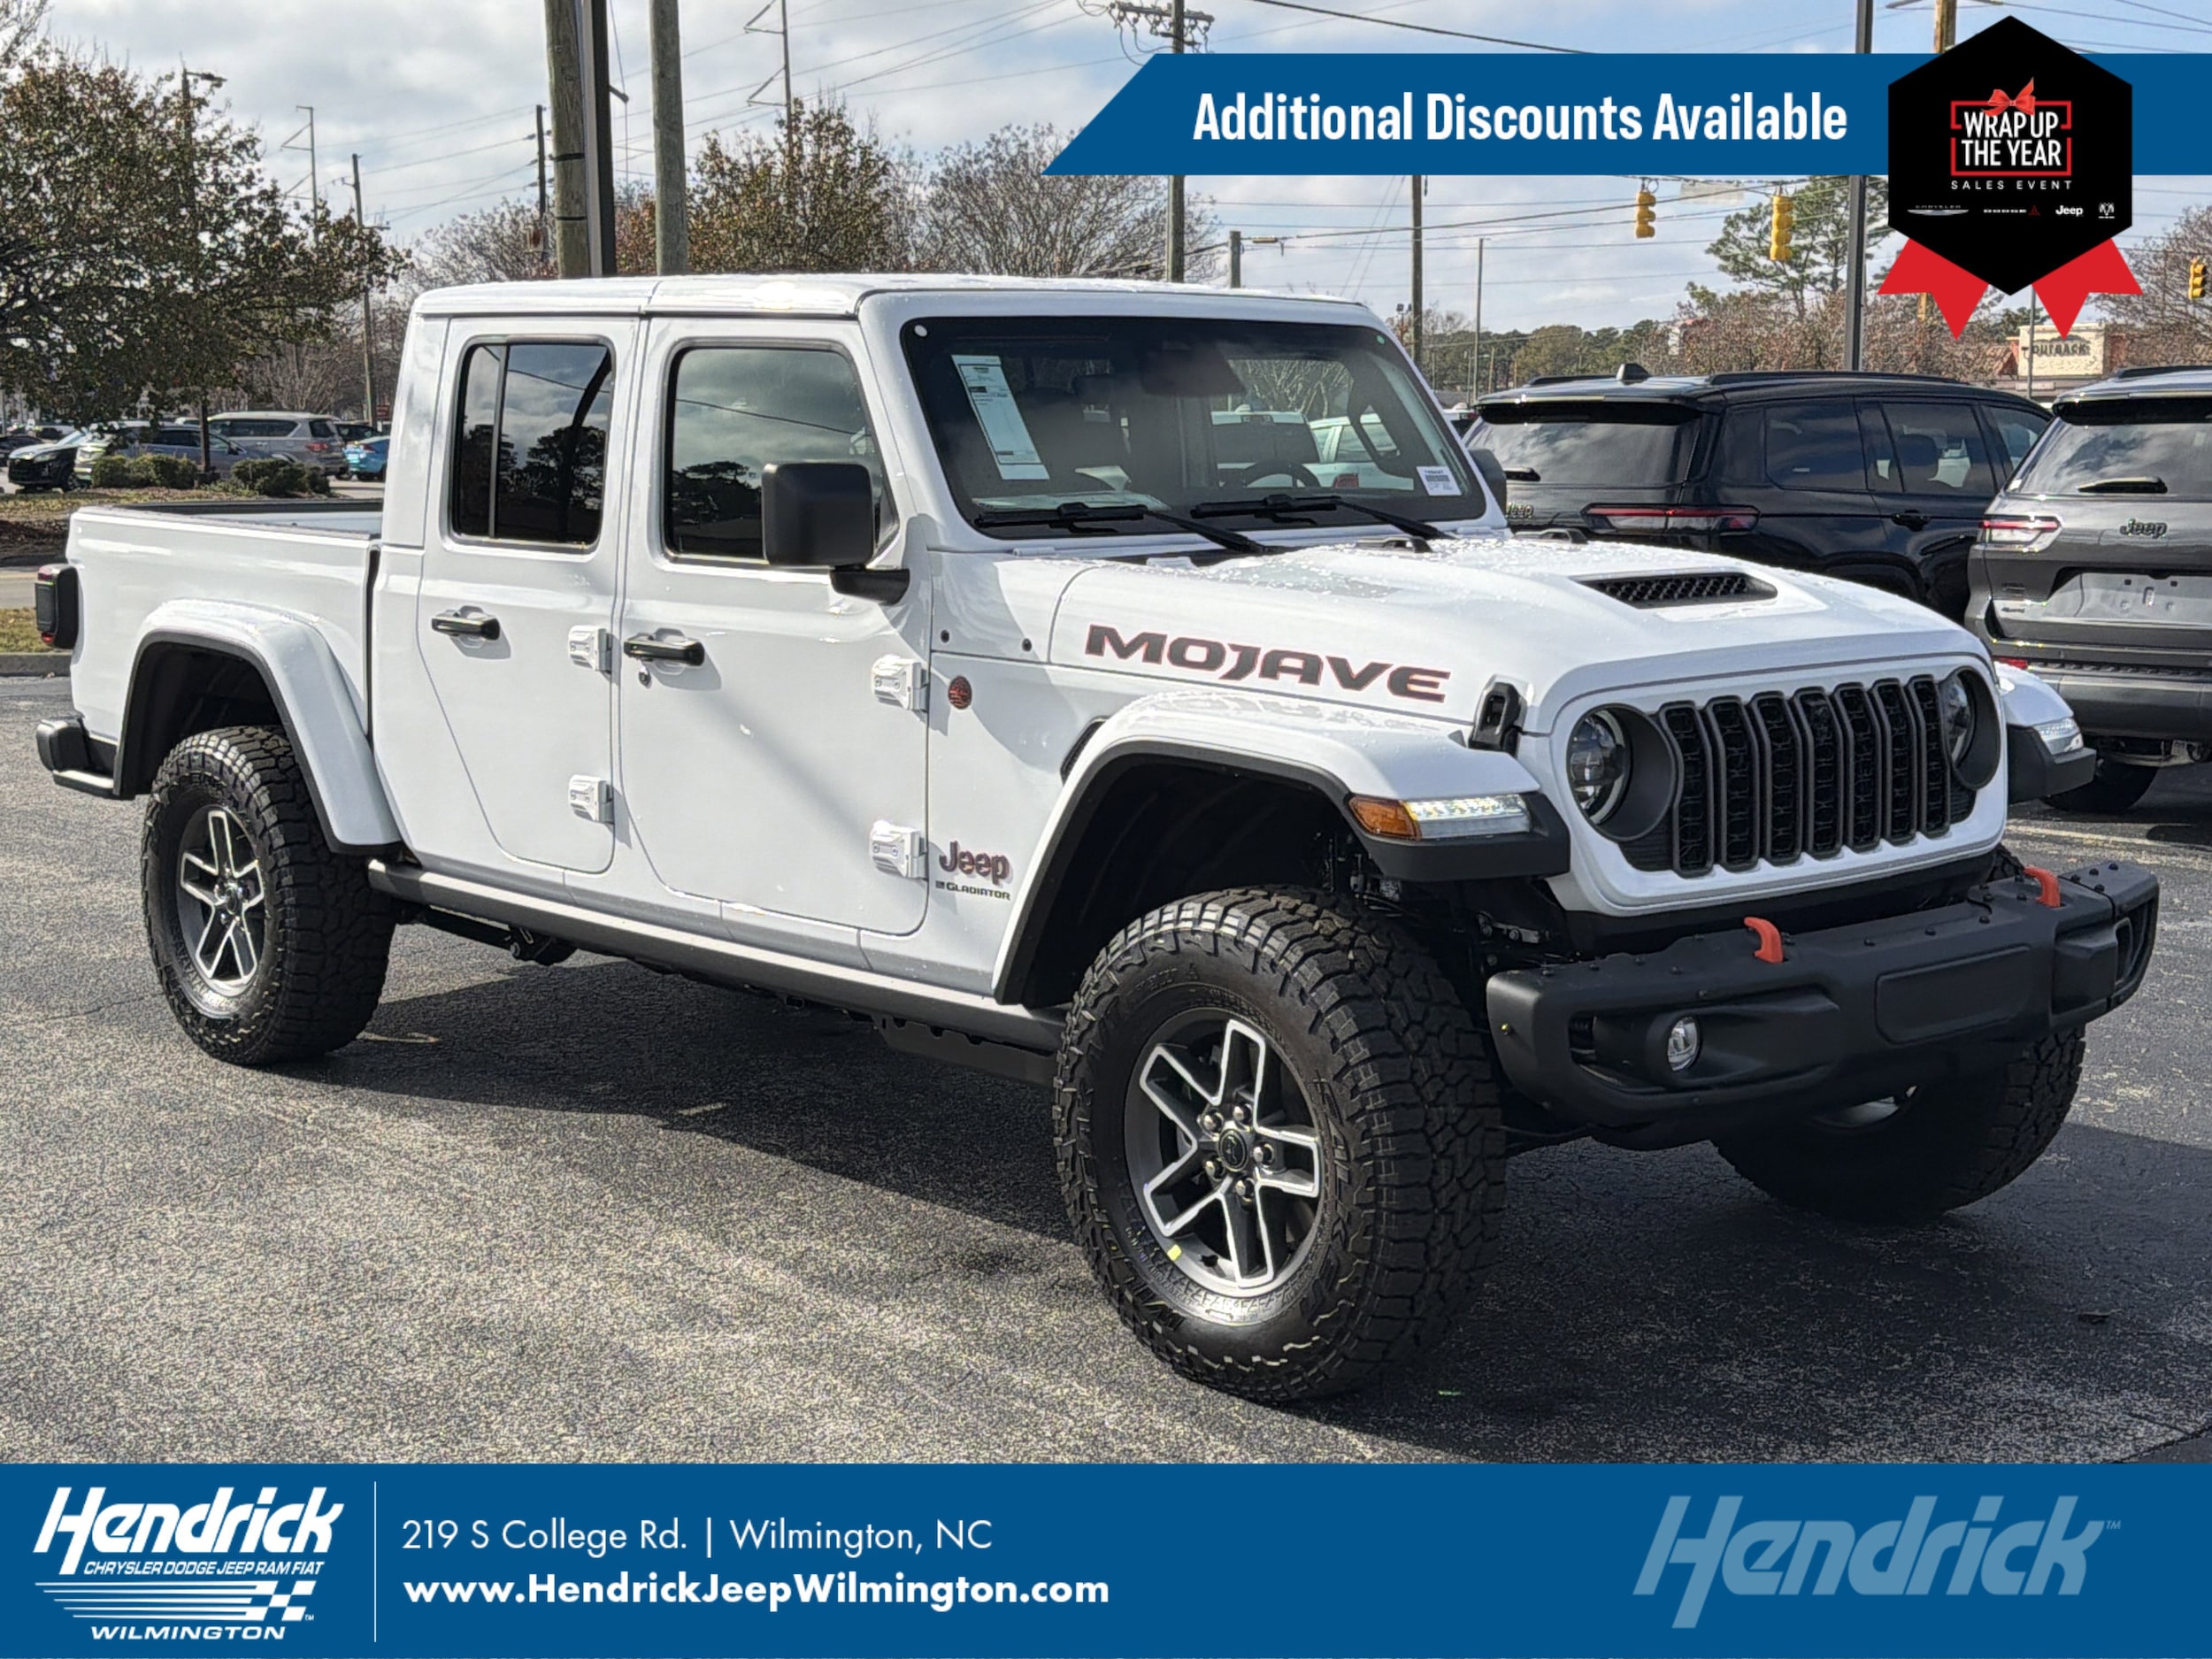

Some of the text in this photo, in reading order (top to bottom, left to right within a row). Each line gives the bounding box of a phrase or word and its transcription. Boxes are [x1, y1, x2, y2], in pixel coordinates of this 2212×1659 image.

[2119, 517, 2168, 540] Jeep
[1085, 625, 1451, 703] MOJAVE
[939, 840, 1010, 887] Jeep
[946, 881, 1010, 901] GLADIATOR
